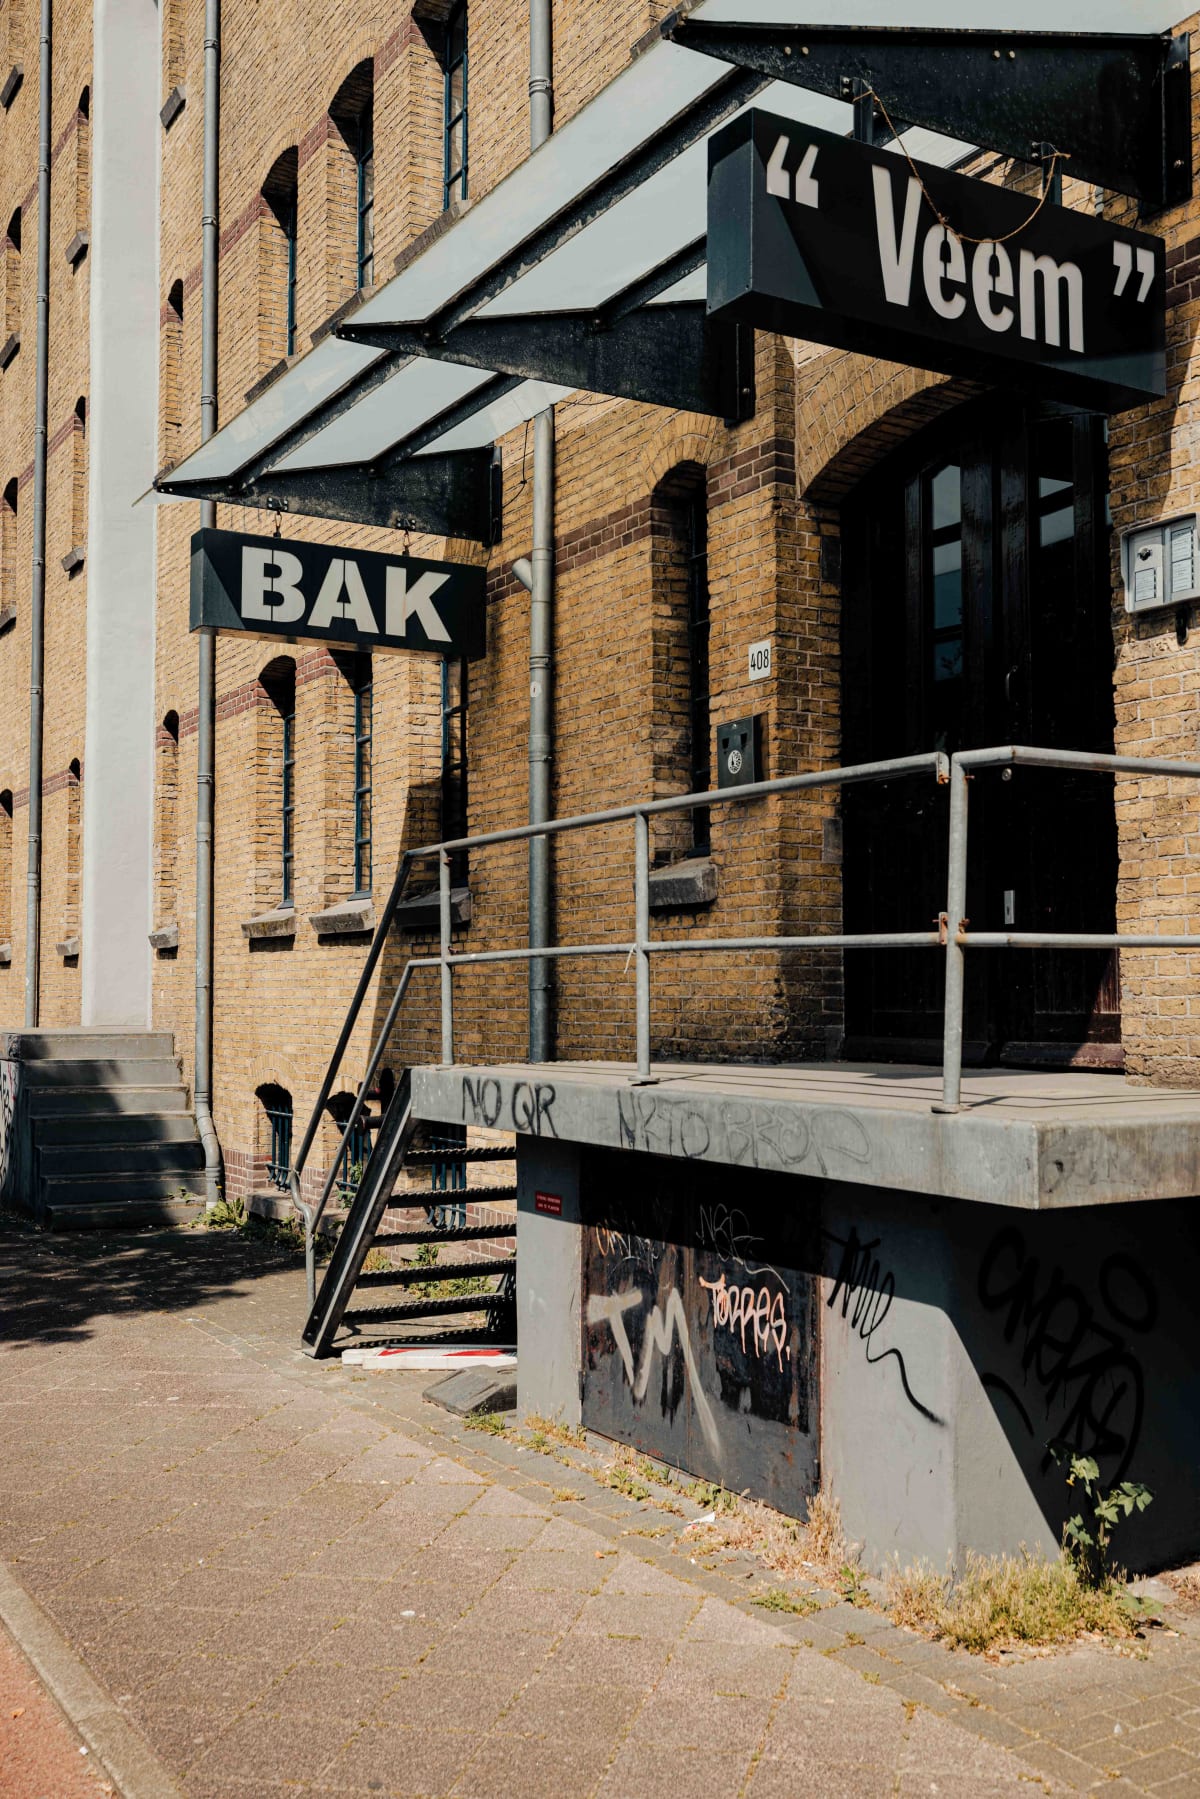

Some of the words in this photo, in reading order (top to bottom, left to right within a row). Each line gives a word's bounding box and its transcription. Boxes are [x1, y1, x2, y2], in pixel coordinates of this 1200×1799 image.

[240, 545, 452, 642] BAK
[751, 649, 769, 671] 408
[462, 1076, 502, 1127] NO
